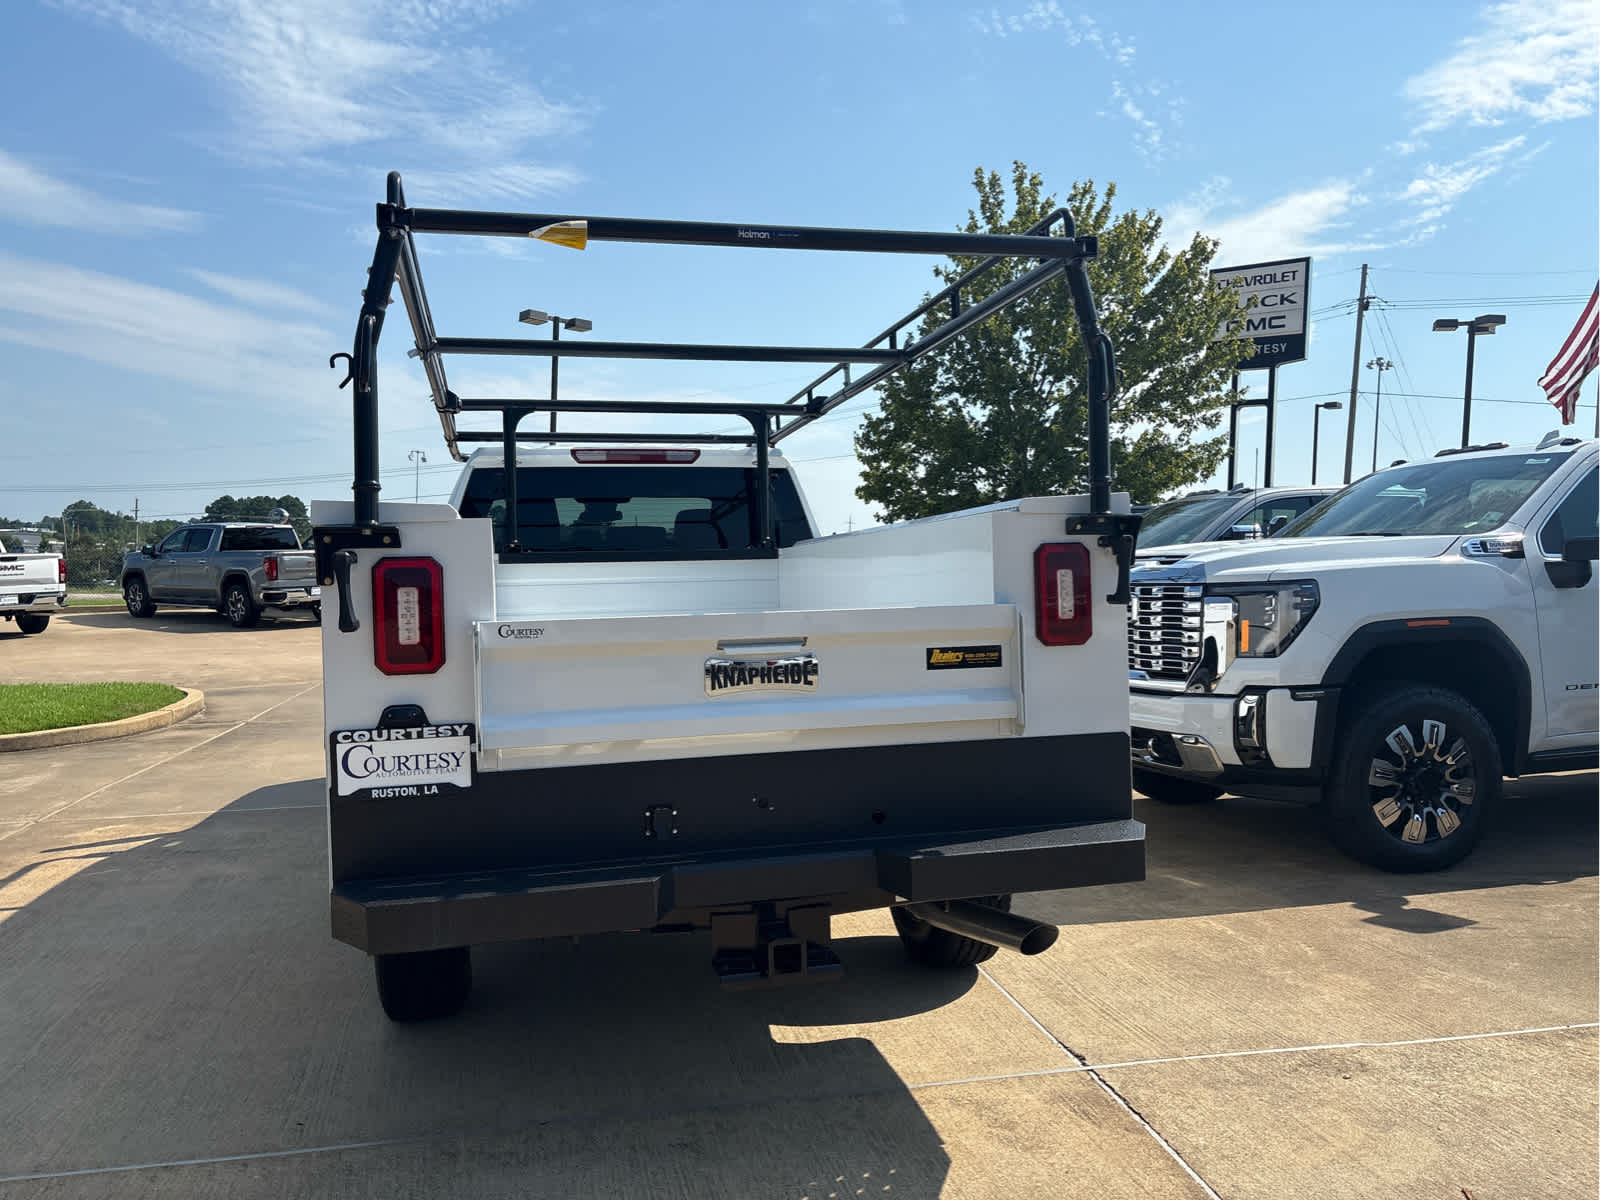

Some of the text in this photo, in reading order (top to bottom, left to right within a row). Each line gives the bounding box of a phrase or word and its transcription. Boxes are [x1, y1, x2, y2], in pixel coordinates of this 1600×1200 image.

[737, 229, 770, 239] Holman
[498, 624, 545, 638] COURTESY
[710, 659, 815, 691] KNAPHEIDE
[336, 724, 469, 743] COURTESY
[341, 744, 465, 779] COURTESY
[371, 784, 439, 799] RUSTON, LA
